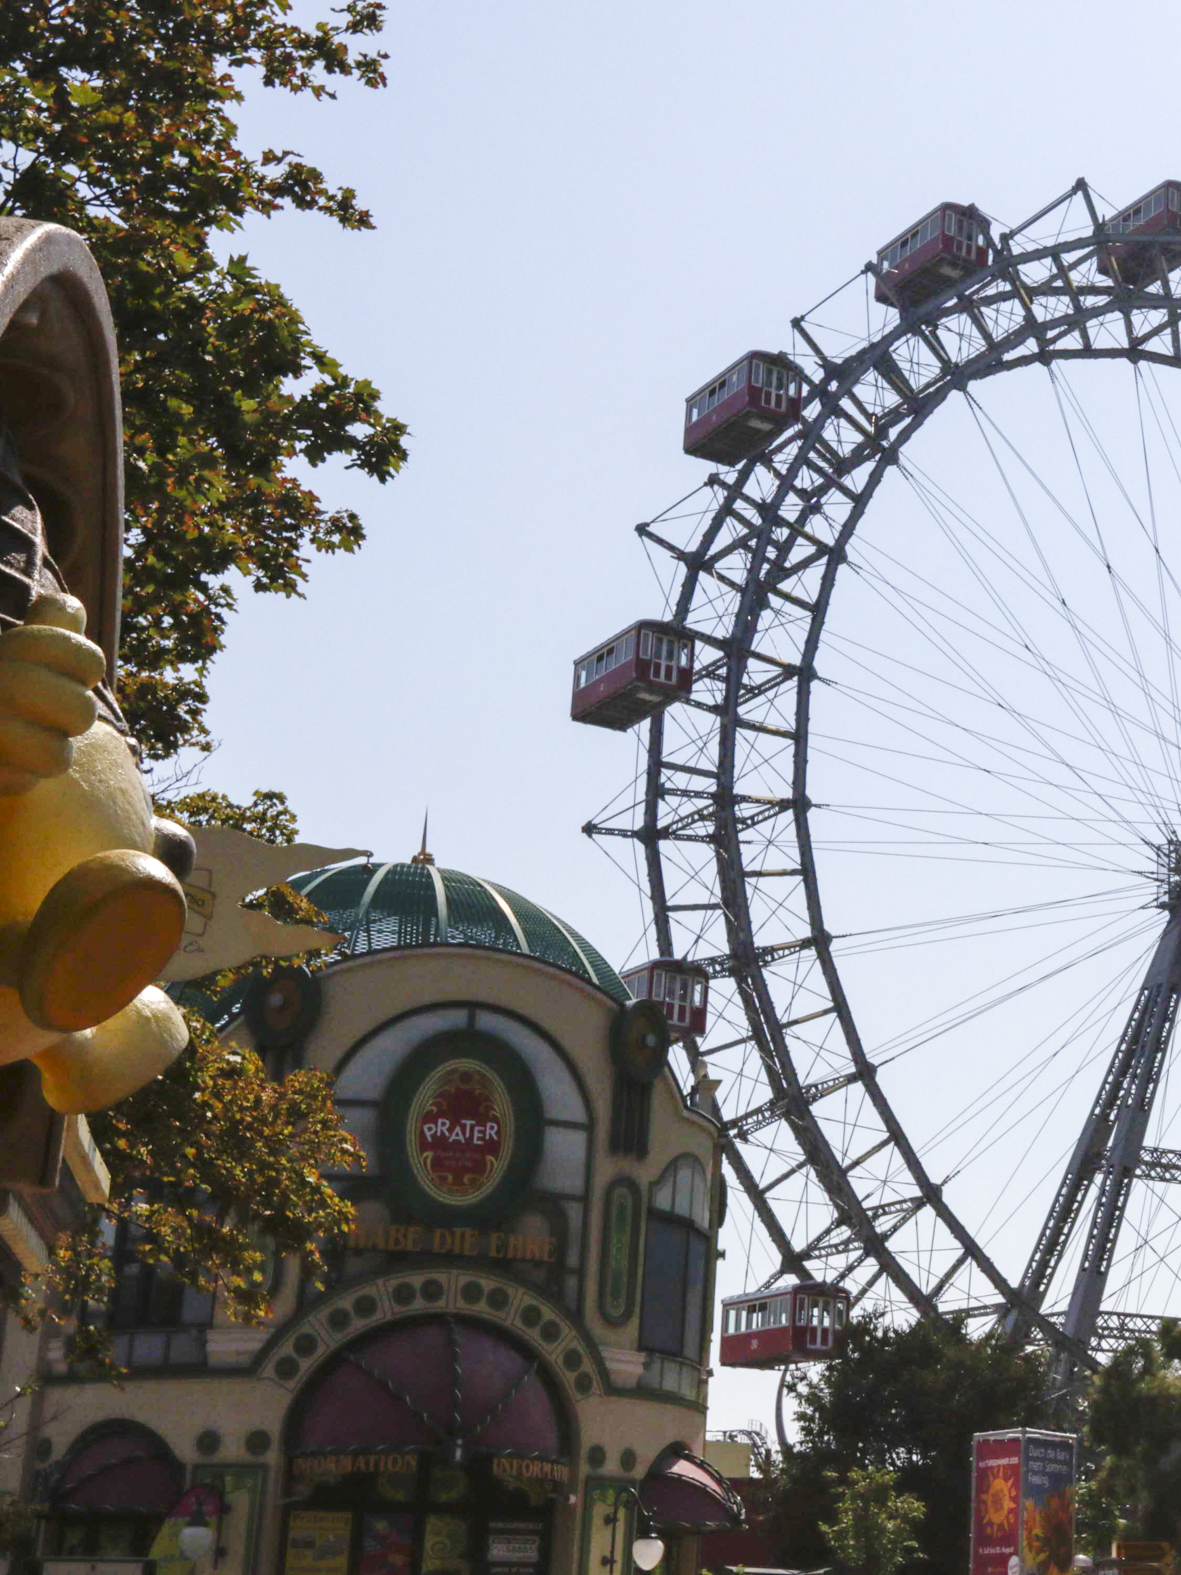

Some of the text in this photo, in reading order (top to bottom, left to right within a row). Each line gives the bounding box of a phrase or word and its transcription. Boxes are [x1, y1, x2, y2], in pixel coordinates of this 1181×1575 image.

[423, 1118, 498, 1145] PRATER
[433, 1227, 479, 1255] DIE
[294, 1453, 417, 1475] INFORMATION
